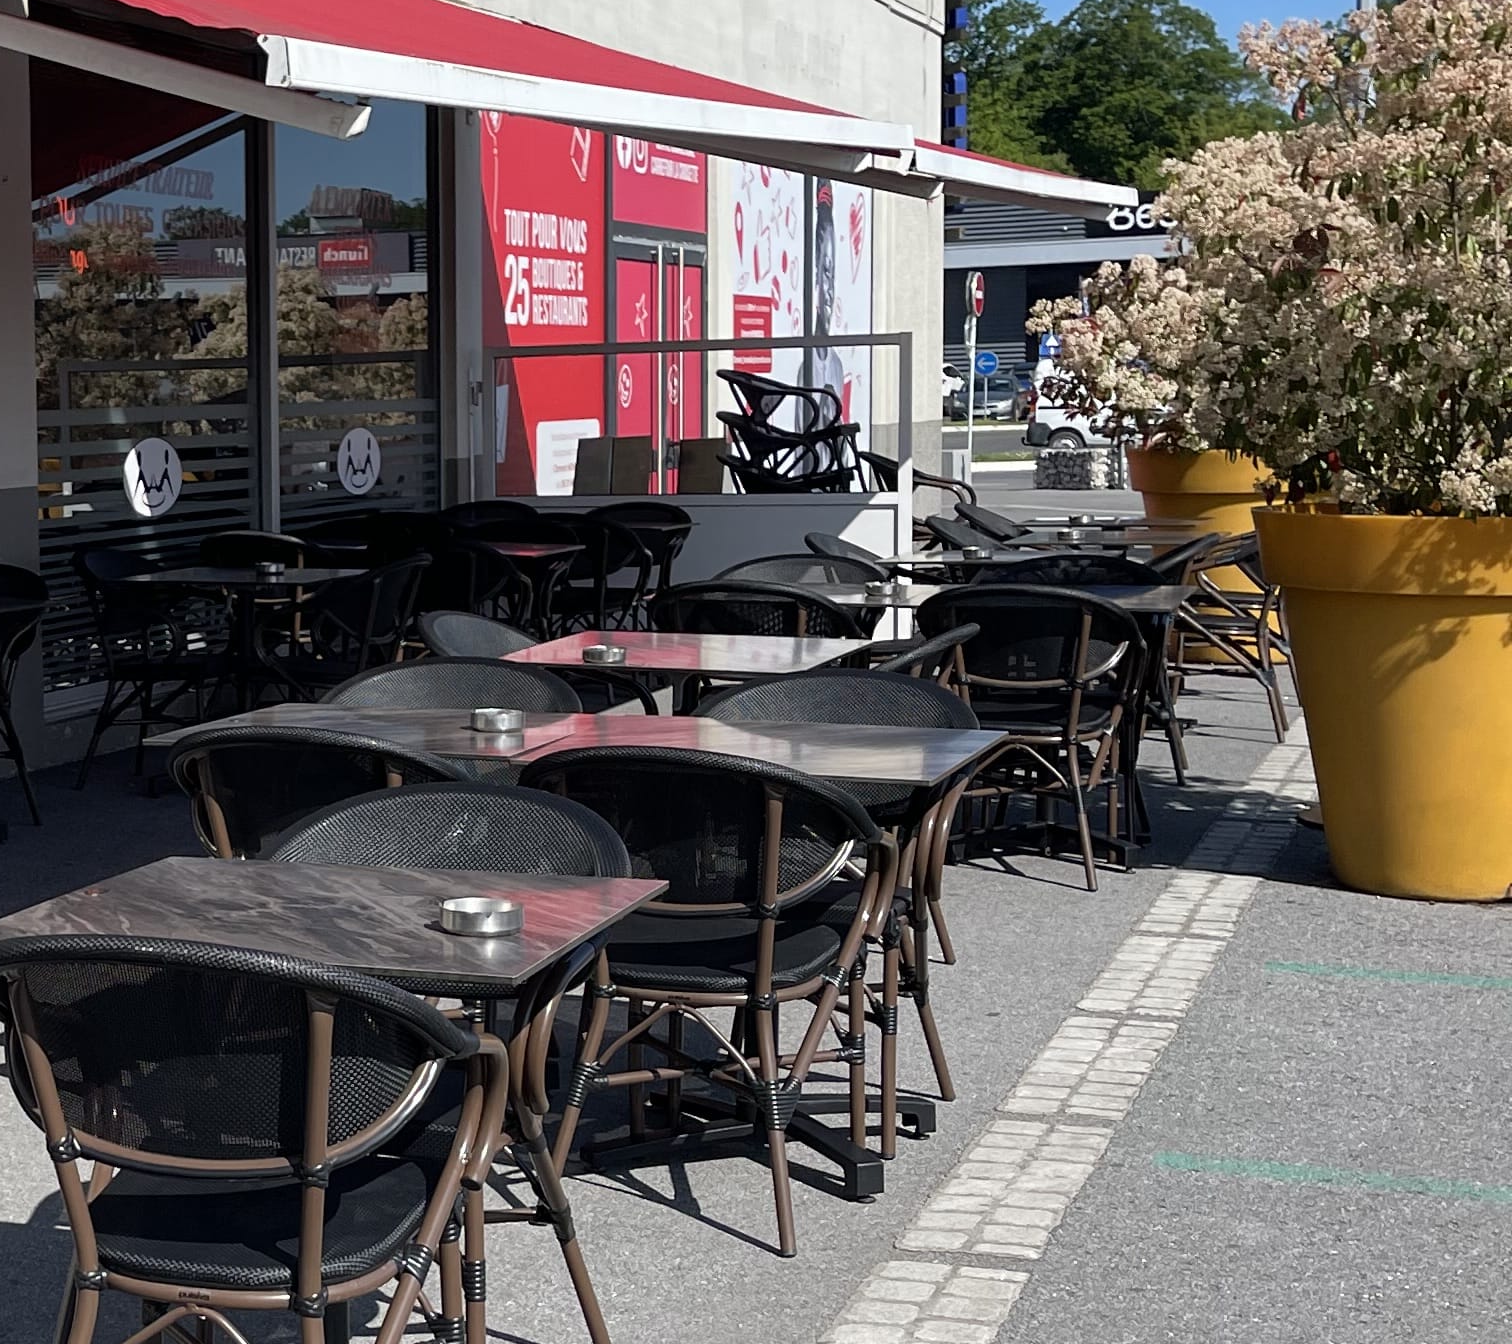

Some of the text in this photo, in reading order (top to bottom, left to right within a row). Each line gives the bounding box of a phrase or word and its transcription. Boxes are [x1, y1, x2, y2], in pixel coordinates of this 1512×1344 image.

[504, 209, 588, 254] TOUT POUR VOUS
[504, 254, 530, 327] 25
[532, 257, 576, 291] BOUTIQUES
[532, 294, 588, 327] RESTAURANTS
